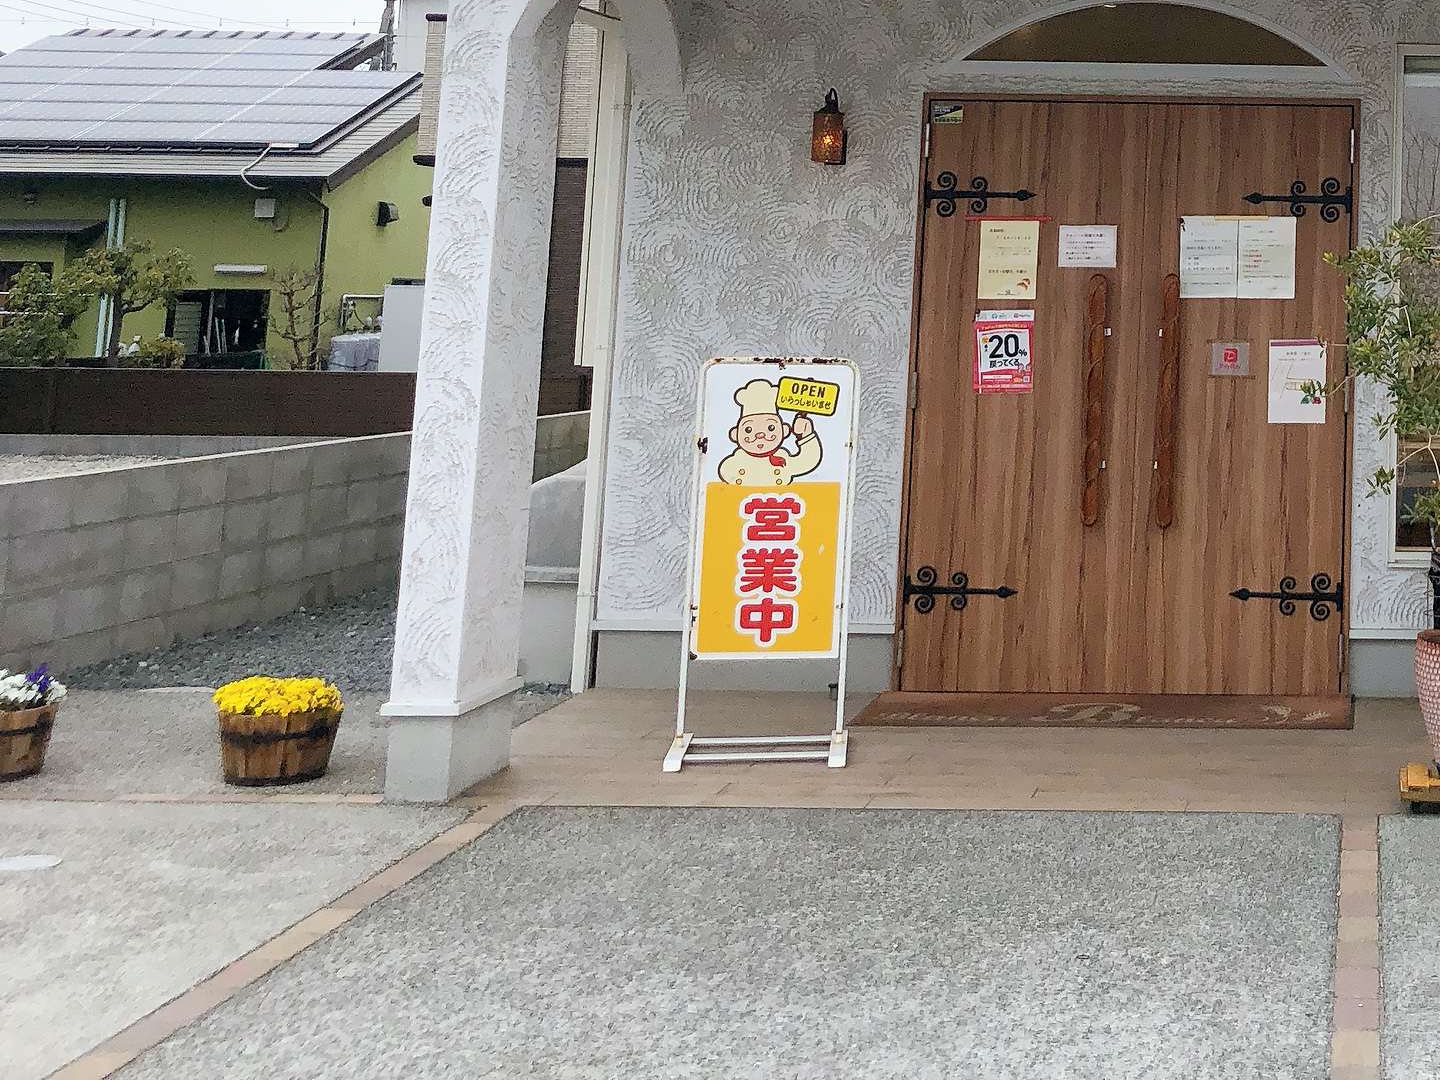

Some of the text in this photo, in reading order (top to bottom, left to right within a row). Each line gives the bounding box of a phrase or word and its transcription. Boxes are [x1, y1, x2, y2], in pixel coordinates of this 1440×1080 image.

[988, 333, 1028, 359] 20%
[791, 382, 826, 399] OPEN
[780, 395, 831, 410] いらっしゃいませ
[739, 497, 801, 643] 営業中
